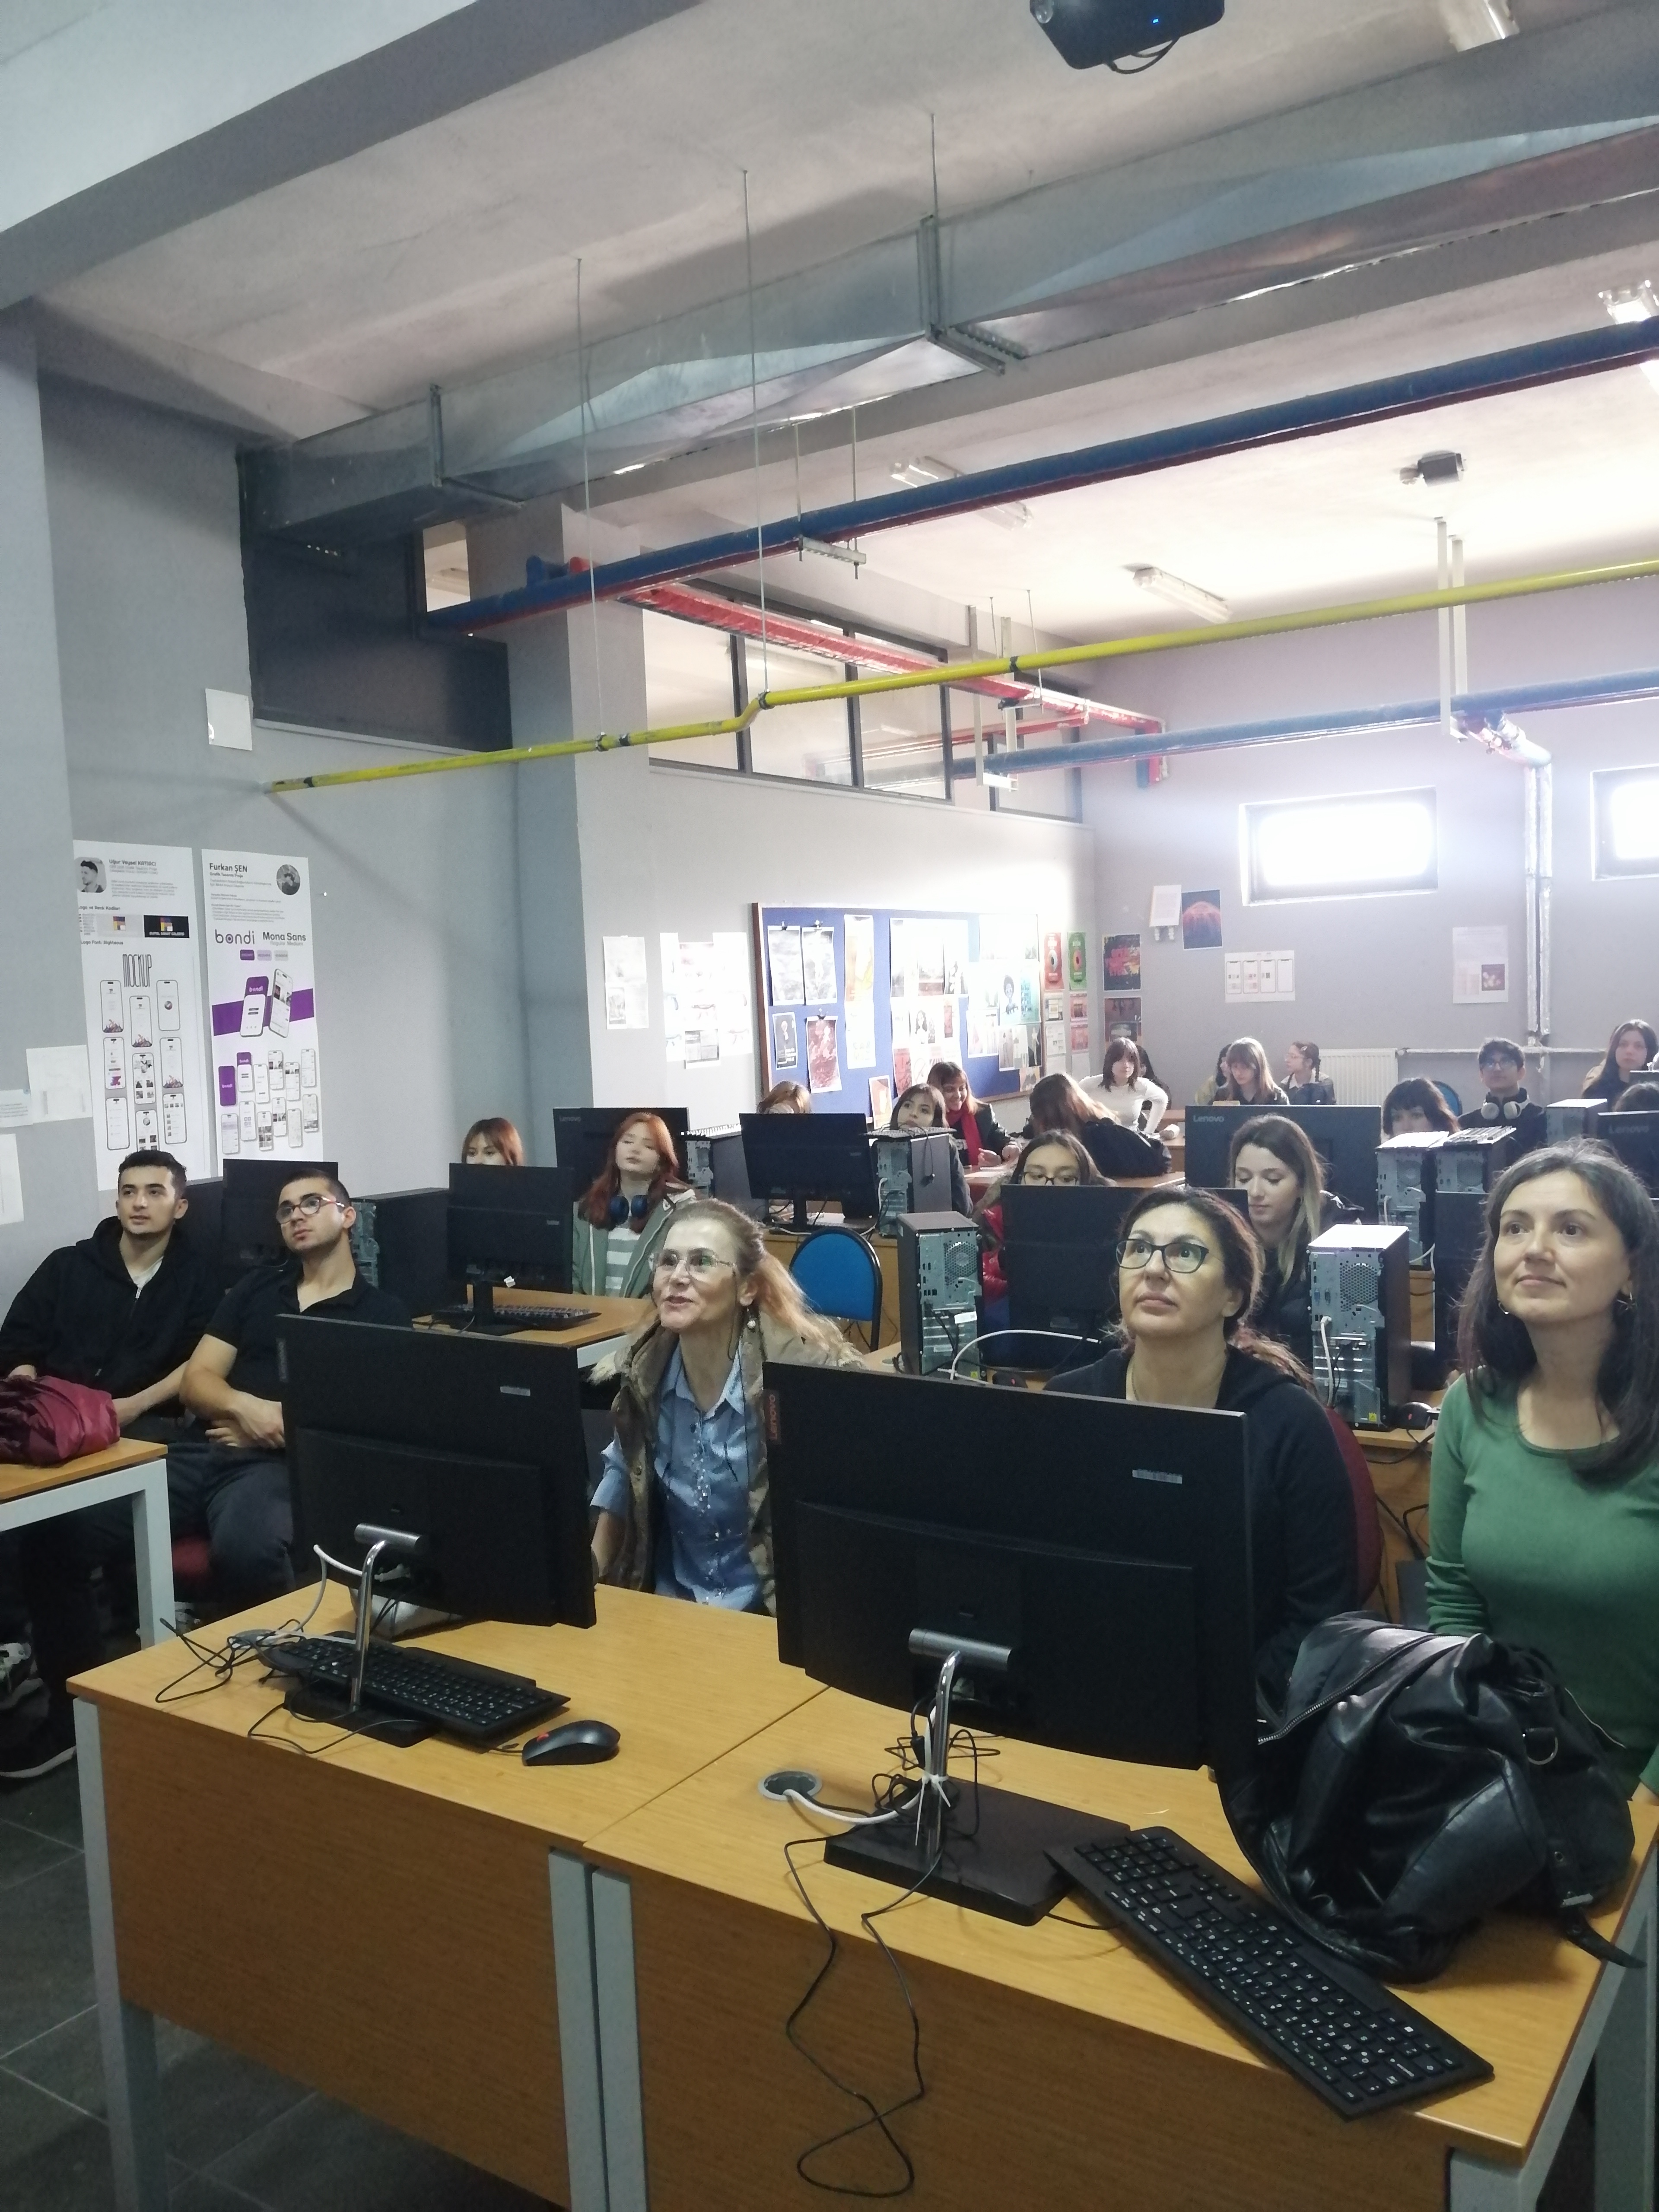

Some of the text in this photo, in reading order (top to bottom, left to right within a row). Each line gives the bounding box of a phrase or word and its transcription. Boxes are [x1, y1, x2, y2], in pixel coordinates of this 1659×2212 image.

[209, 863, 248, 874] Furkan ŞEN
[215, 929, 255, 945] bondi
[263, 931, 306, 941] Mona Sans
[123, 954, 152, 988] MOCKUP
[1609, 1125, 1649, 1134] Lenovo
